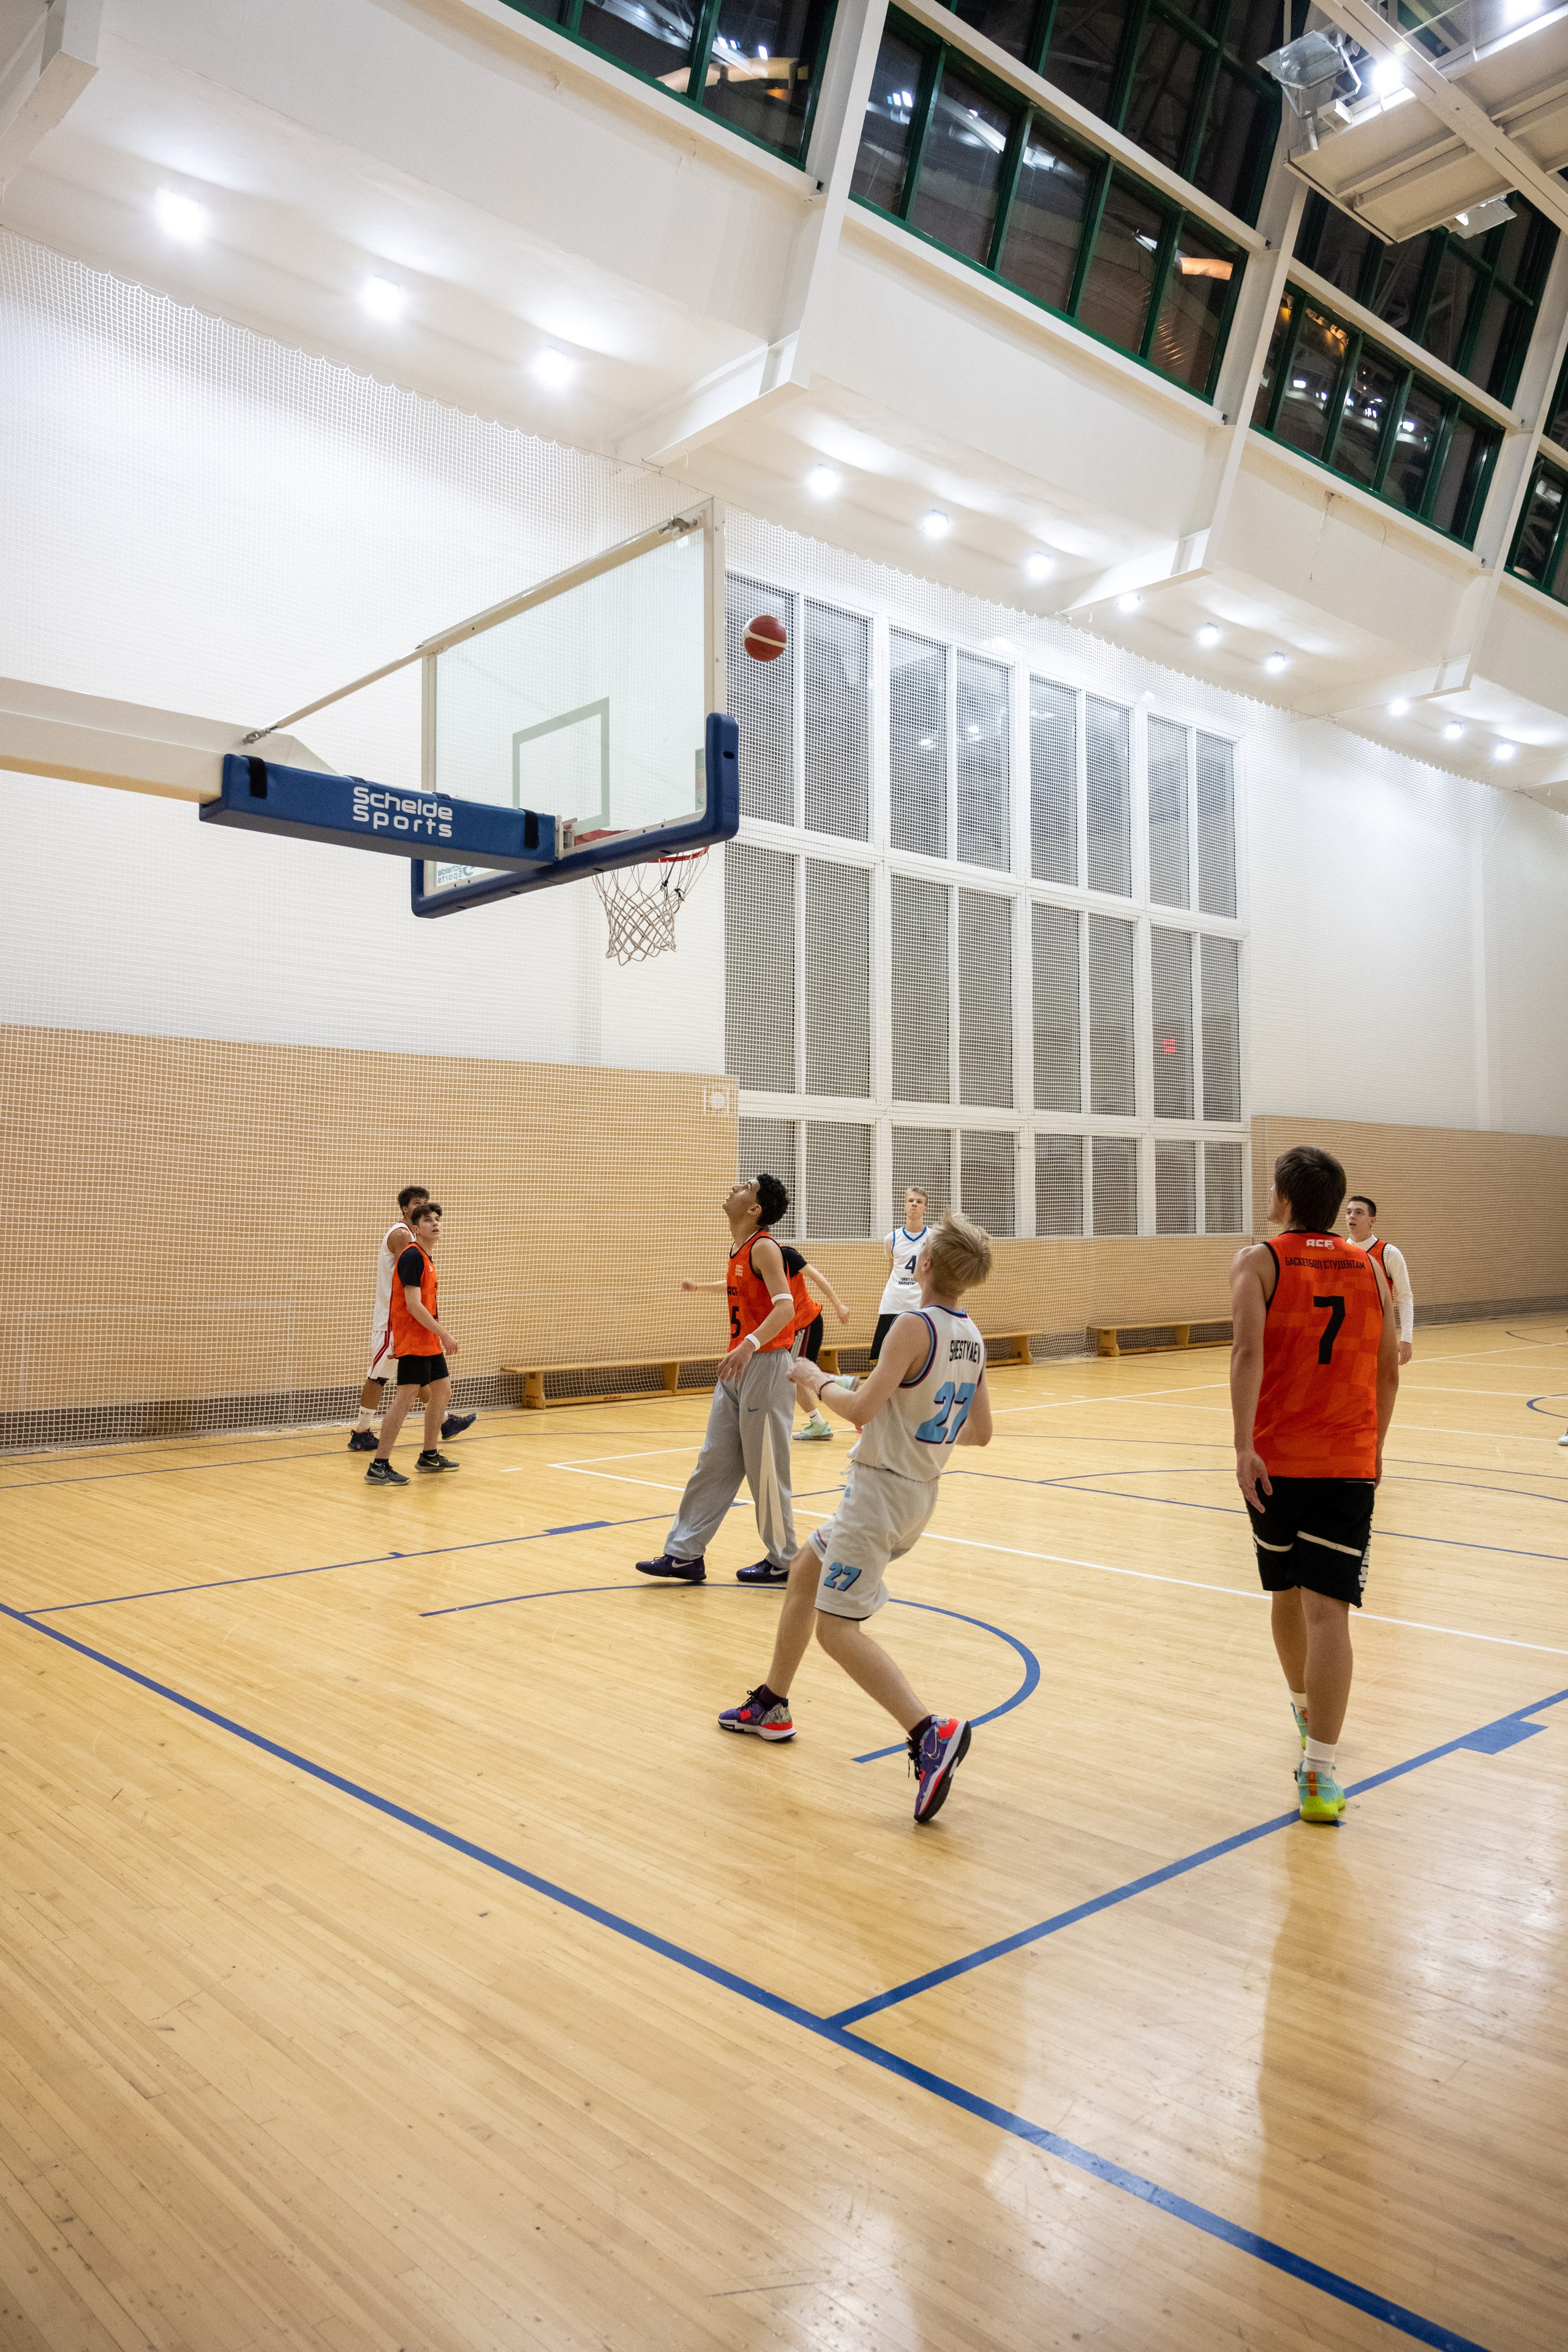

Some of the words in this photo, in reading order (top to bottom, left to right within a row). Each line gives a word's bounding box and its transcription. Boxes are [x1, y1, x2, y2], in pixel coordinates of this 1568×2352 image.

[353, 786, 453, 821] Schelde
[353, 804, 452, 837] Sports
[905, 1255, 917, 1274] 4
[1285, 1257, 1322, 1269] БАСКЕТБОЛ
[1324, 1260, 1365, 1270] СТУДЕНТАМ
[731, 1306, 741, 1338] 5
[1314, 1295, 1345, 1365] 7
[915, 1381, 976, 1444] 27
[824, 1561, 862, 1591] 27
